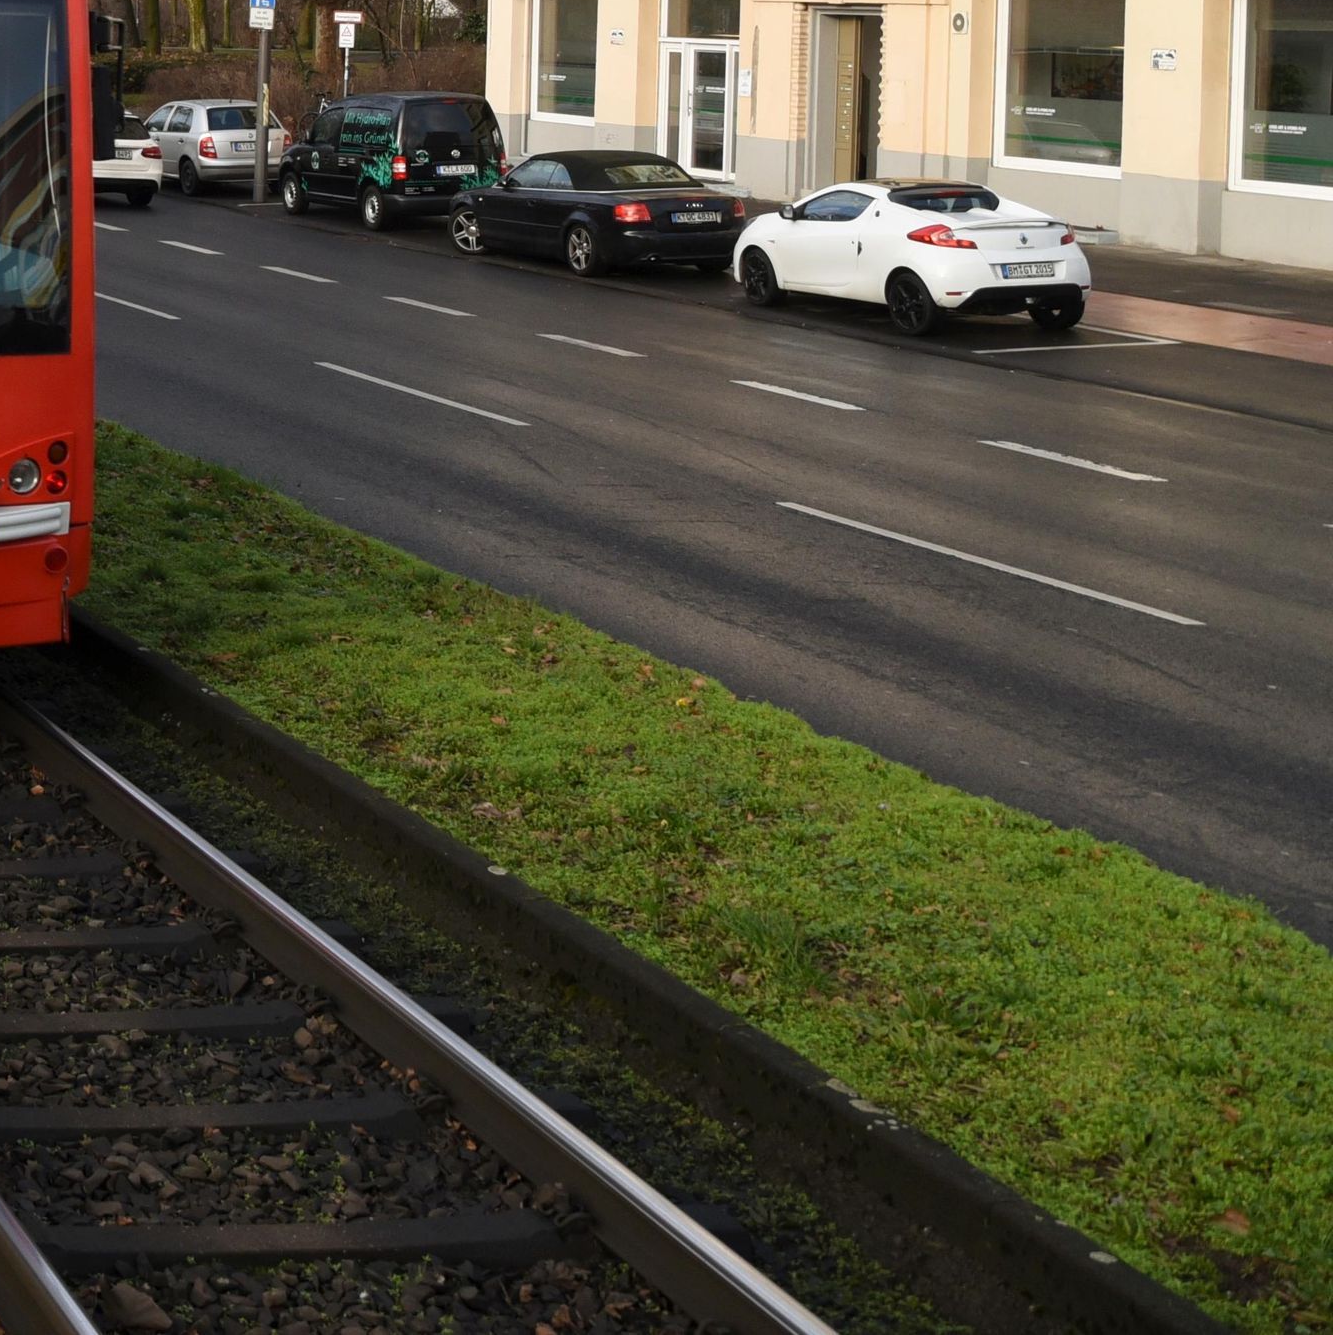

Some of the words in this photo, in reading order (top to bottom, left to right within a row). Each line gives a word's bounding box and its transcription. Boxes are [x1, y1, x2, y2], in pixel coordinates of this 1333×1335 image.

[355, 112, 392, 127] Hydro-Plan
[352, 131, 363, 144] ins
[363, 131, 389, 145] Grüne!
[1023, 265, 1034, 275] GT
[1035, 264, 1053, 274] 2015
